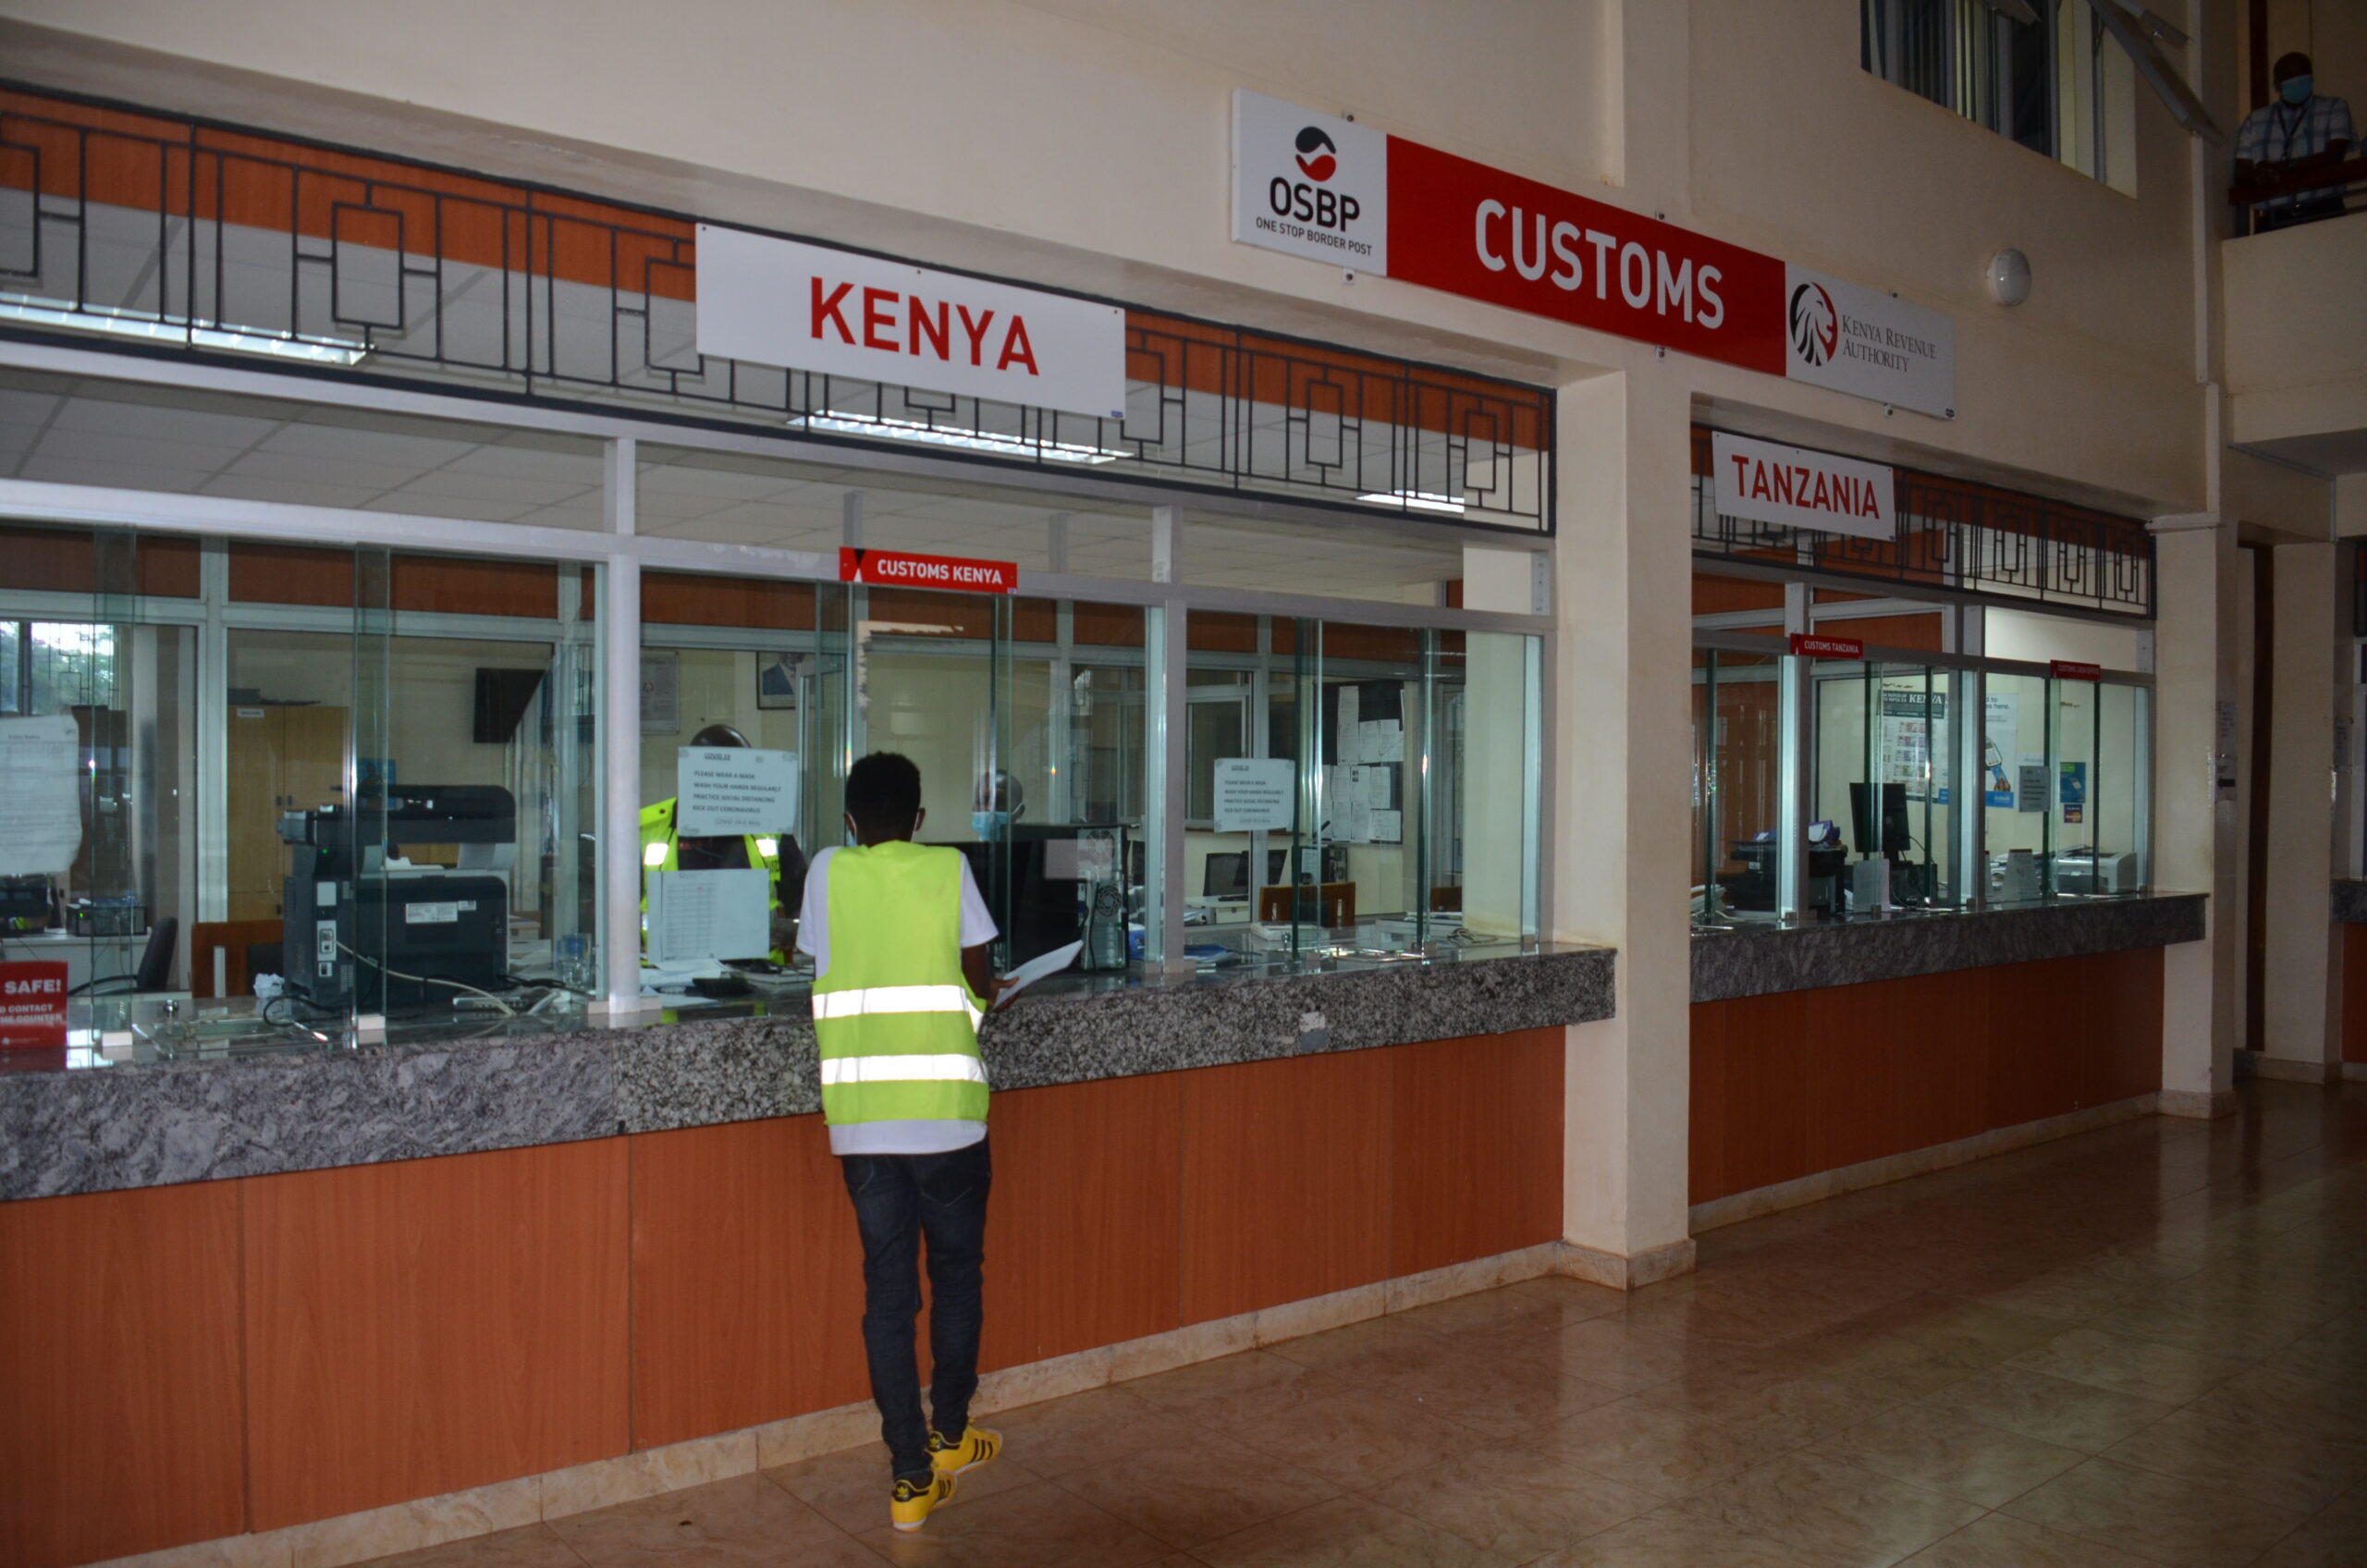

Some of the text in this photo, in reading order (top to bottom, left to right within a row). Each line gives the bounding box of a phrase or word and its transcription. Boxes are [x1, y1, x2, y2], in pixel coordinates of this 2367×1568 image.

[1269, 177, 1360, 232] OSBP
[1256, 216, 1373, 256] ONE STOP BORDER POST
[1475, 198, 1724, 329] CUSTOMS
[810, 276, 1040, 376] KENYA
[1842, 314, 1937, 360] KENYA REVENUE
[1843, 338, 1909, 373] AUTHORITY
[1731, 454, 1880, 520] TANZANIA
[877, 558, 1002, 585] CUSTOMS KENYA
[1804, 640, 1859, 653] CUSTOMS TANZANIA
[5, 978, 62, 994] SAFE!
[8, 1003, 54, 1014] CONTACT
[17, 1013, 62, 1023] COUNTER
